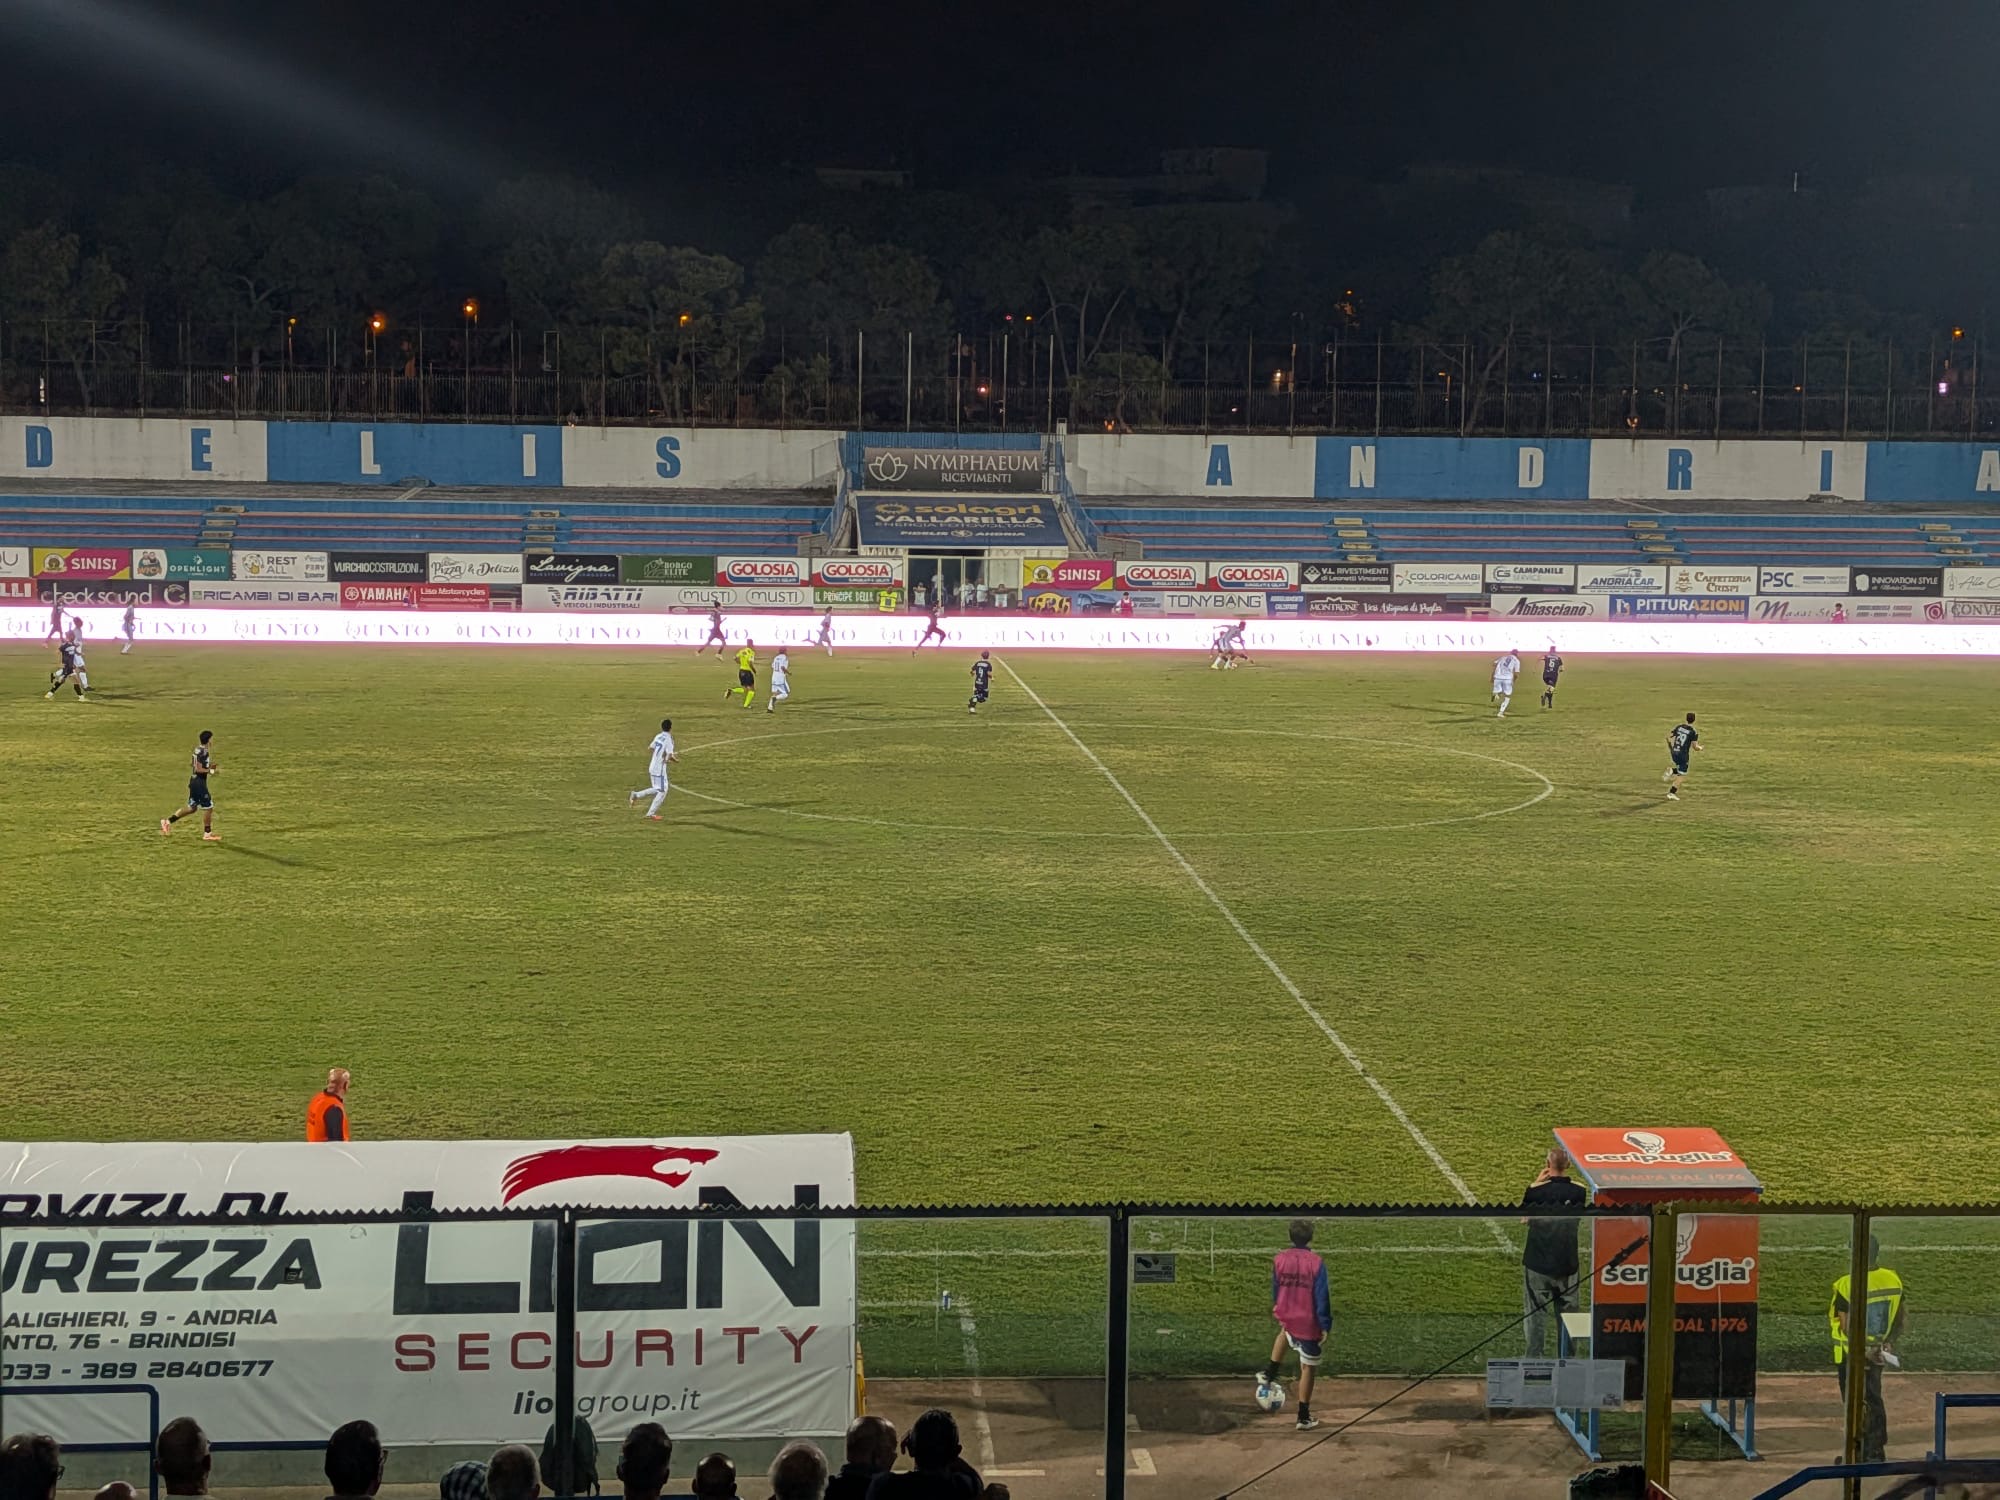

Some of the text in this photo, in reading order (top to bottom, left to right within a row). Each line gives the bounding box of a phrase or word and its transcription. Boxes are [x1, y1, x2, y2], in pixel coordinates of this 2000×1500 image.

[913, 454, 1039, 471] NYMPHAEUM
[941, 473, 1012, 484] RICEVIMENTI
[914, 503, 1041, 515] solagri
[875, 515, 1044, 524] VALLARELLA
[71, 557, 117, 570] SINISI
[266, 556, 298, 566] REST
[169, 565, 226, 573] OPENLIGHT
[476, 562, 520, 576] Delizia
[731, 563, 796, 576] GOLOSIA
[826, 564, 889, 577] GOLOSIA
[1058, 568, 1101, 580] SINISI
[1130, 568, 1193, 580] GOLOSIA
[1221, 569, 1285, 581] GOLOSIA
[1337, 567, 1389, 575] RIVESTIMENTI
[1763, 572, 1794, 588] PSC
[203, 591, 338, 602] RICAMBI DI BARI
[1507, 597, 1587, 616] Abbasciano
[1636, 599, 1745, 612] PITTURAZIONI
[1586, 1152, 1730, 1164] seripuglia
[1671, 1173, 1701, 1182] DAL
[1709, 1173, 1745, 1182] 1976
[393, 1184, 821, 1315] LION
[1604, 1261, 1747, 1287] seruglia
[4, 1311, 129, 1329] ALIGHIERI,
[138, 1311, 157, 1326] 9
[184, 1309, 278, 1326] ANDRIA
[1674, 1319, 1705, 1333] DAL
[1711, 1319, 1749, 1333] 1976
[3, 1333, 58, 1351] NTO,
[69, 1333, 101, 1350] 76
[128, 1331, 236, 1349] BRINDISI
[394, 1326, 819, 1372] SECURITY
[81, 1362, 137, 1379] 389
[147, 1359, 275, 1378] 2840677
[512, 1387, 701, 1417] liogroup.it
